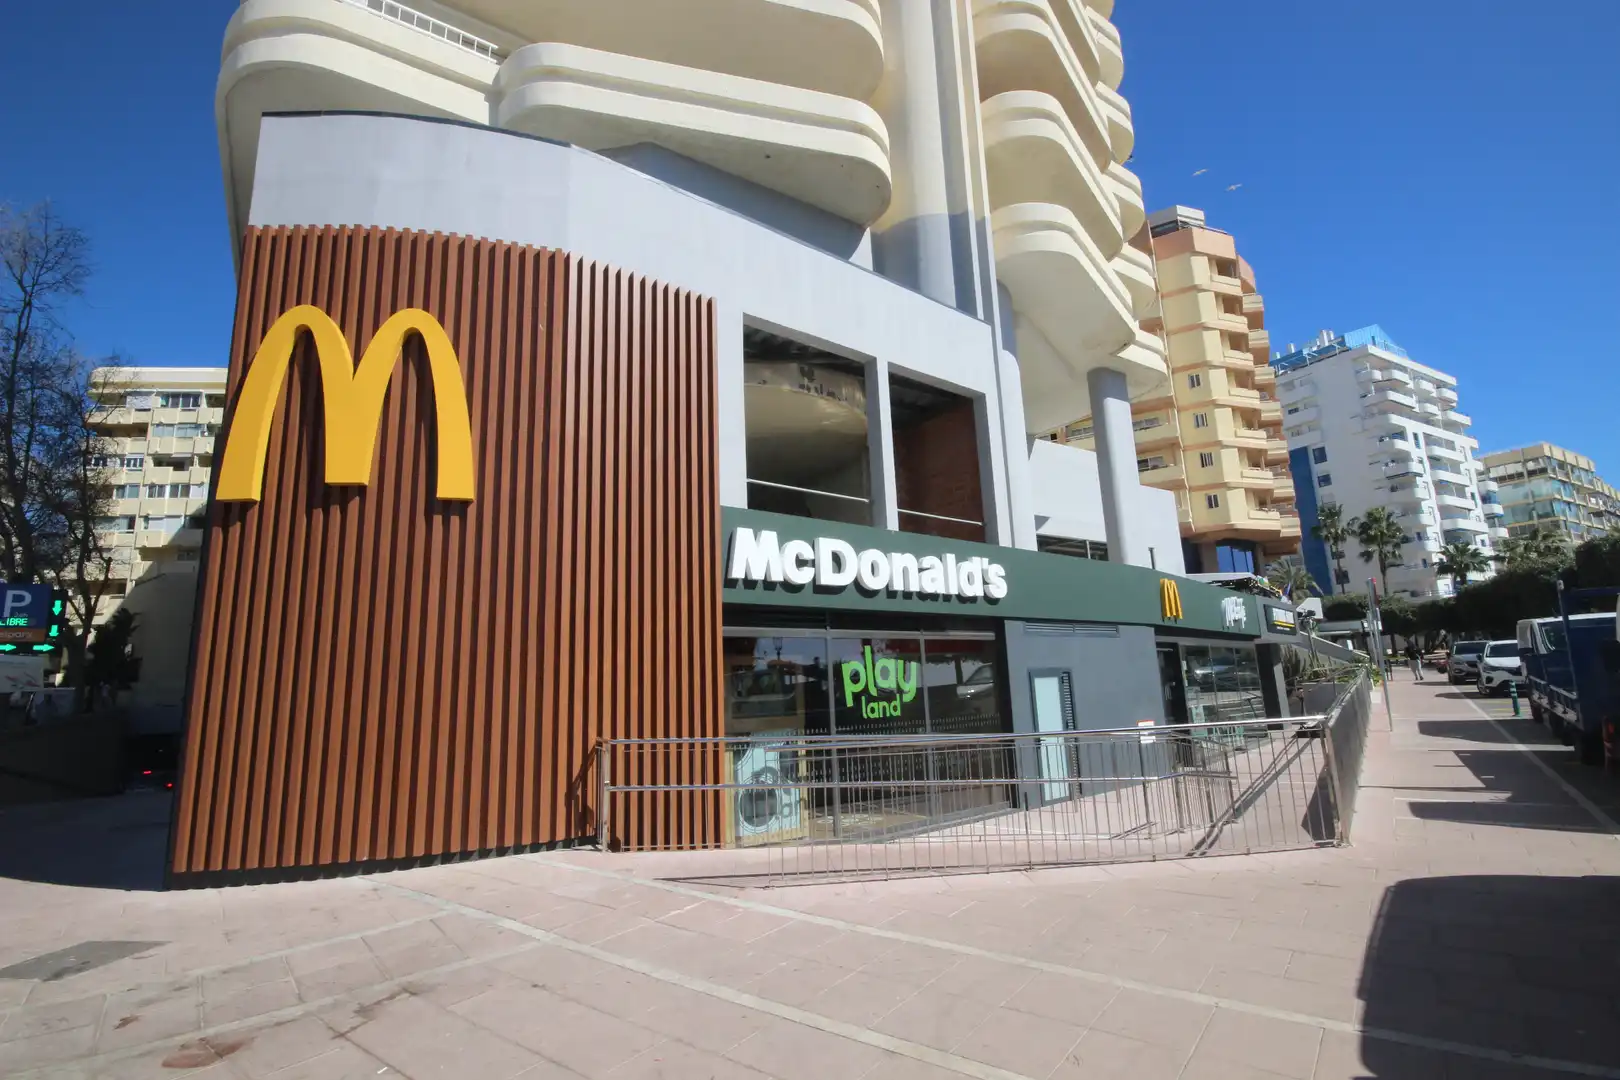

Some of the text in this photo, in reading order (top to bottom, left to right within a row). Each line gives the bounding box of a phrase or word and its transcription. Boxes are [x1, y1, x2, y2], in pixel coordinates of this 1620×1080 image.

[727, 527, 1008, 599] McDonald's
[3, 589, 32, 618] P
[841, 645, 917, 708] play
[861, 693, 902, 719] land
